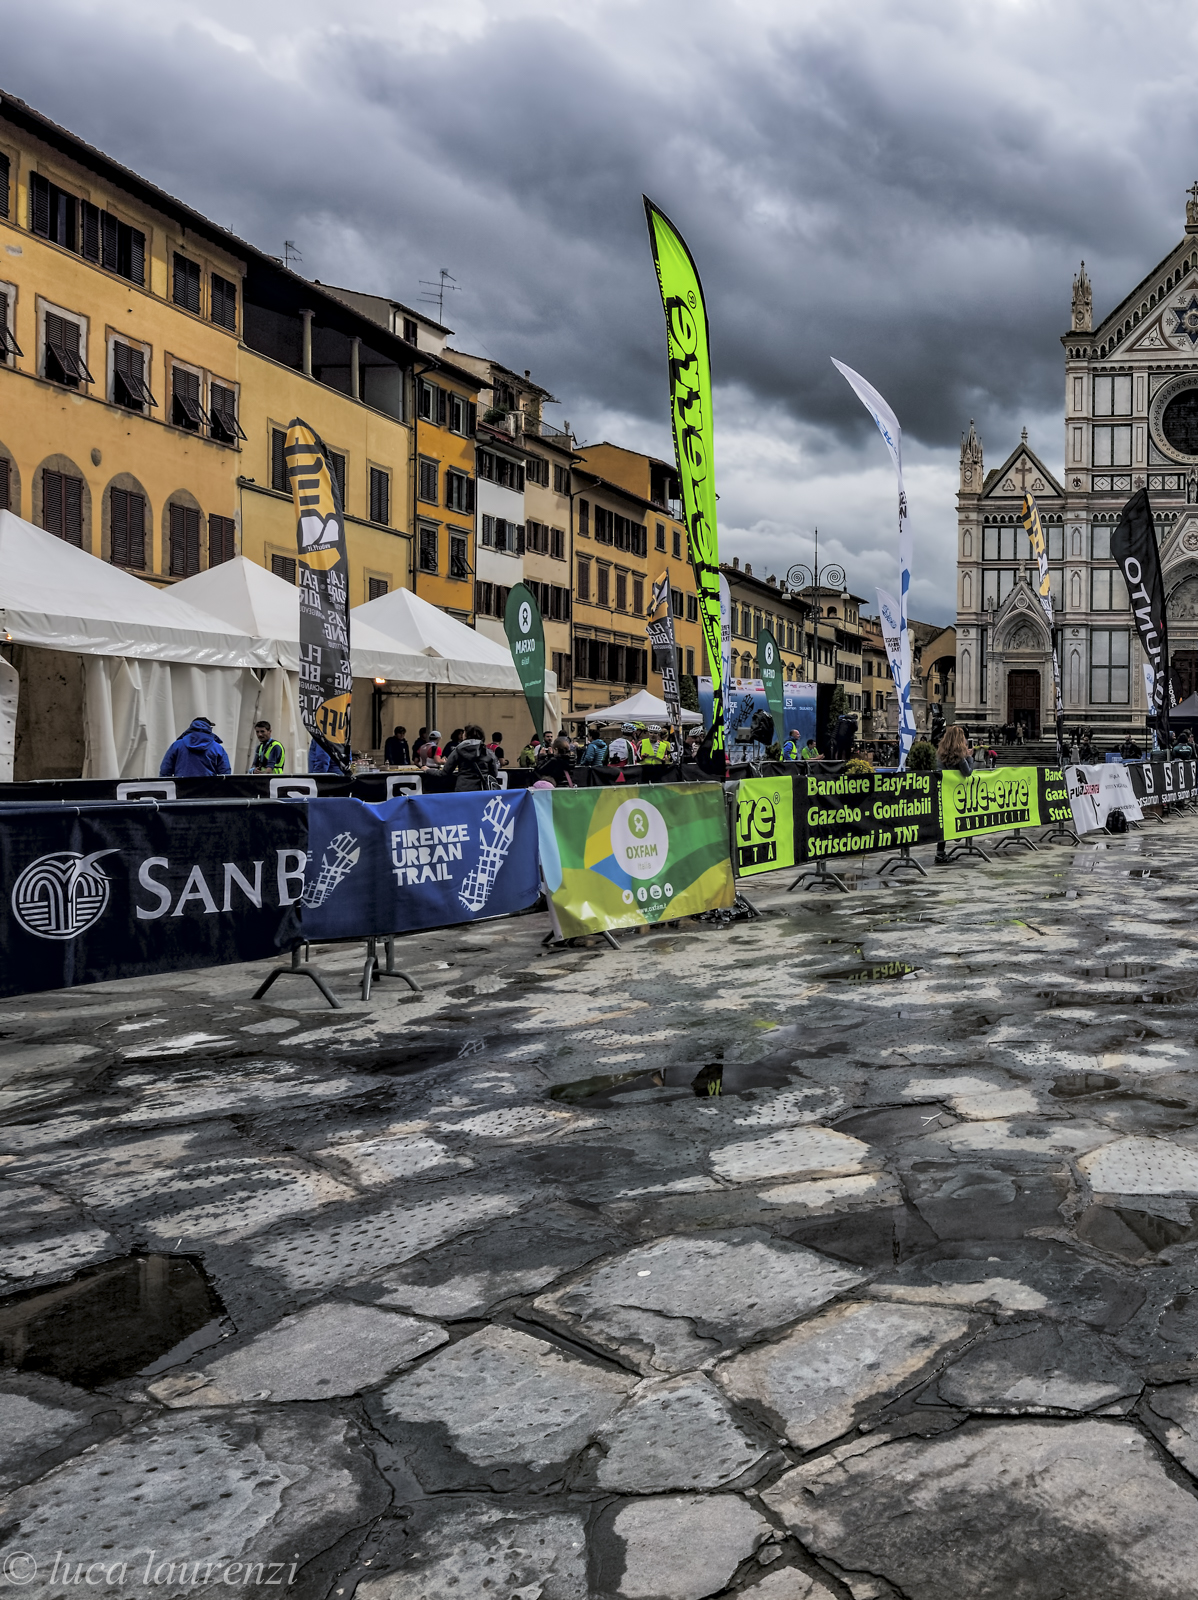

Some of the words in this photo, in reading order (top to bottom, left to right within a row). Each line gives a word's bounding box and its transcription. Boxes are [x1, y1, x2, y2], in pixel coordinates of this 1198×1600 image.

[807, 775, 870, 796] Bandiere
[874, 773, 930, 794] Easy-Flag
[953, 775, 1029, 814] elle-erre
[807, 805, 861, 826] Gazebo
[872, 798, 932, 820] Gonfiabili
[391, 824, 470, 849] FIRENZE
[807, 829, 875, 857] Striscioni
[878, 827, 892, 846] in
[894, 825, 919, 844] TNT
[392, 843, 463, 867] URBAN
[626, 844, 658, 860] OXFAM
[392, 863, 453, 887] TRAIL
